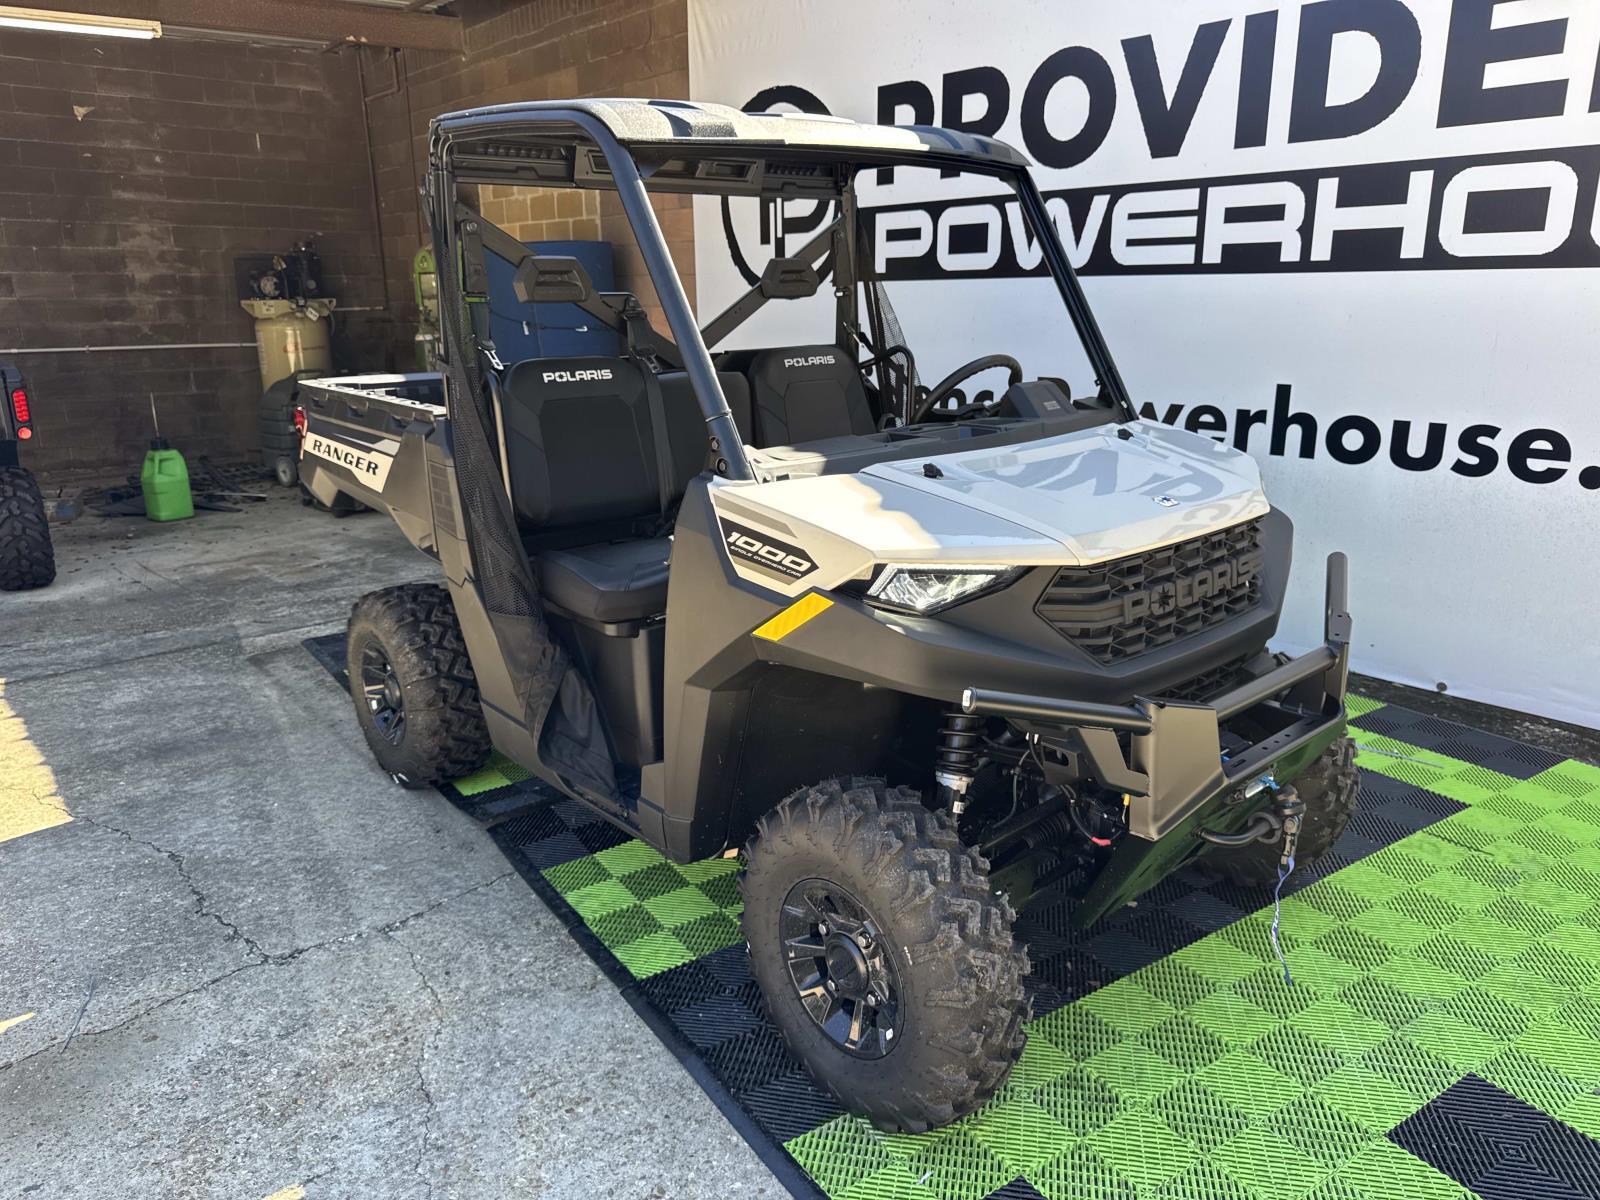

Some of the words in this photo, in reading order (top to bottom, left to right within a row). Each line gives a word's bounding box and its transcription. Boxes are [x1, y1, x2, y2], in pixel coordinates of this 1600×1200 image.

[876, 0, 1600, 186] PROVIDE
[874, 160, 1600, 274] POWERHO
[542, 369, 613, 383] POLARIS
[784, 355, 836, 368] POLARIS
[313, 439, 379, 476] RANGER
[727, 531, 812, 572] 1000
[1122, 555, 1255, 624] POLARIS
